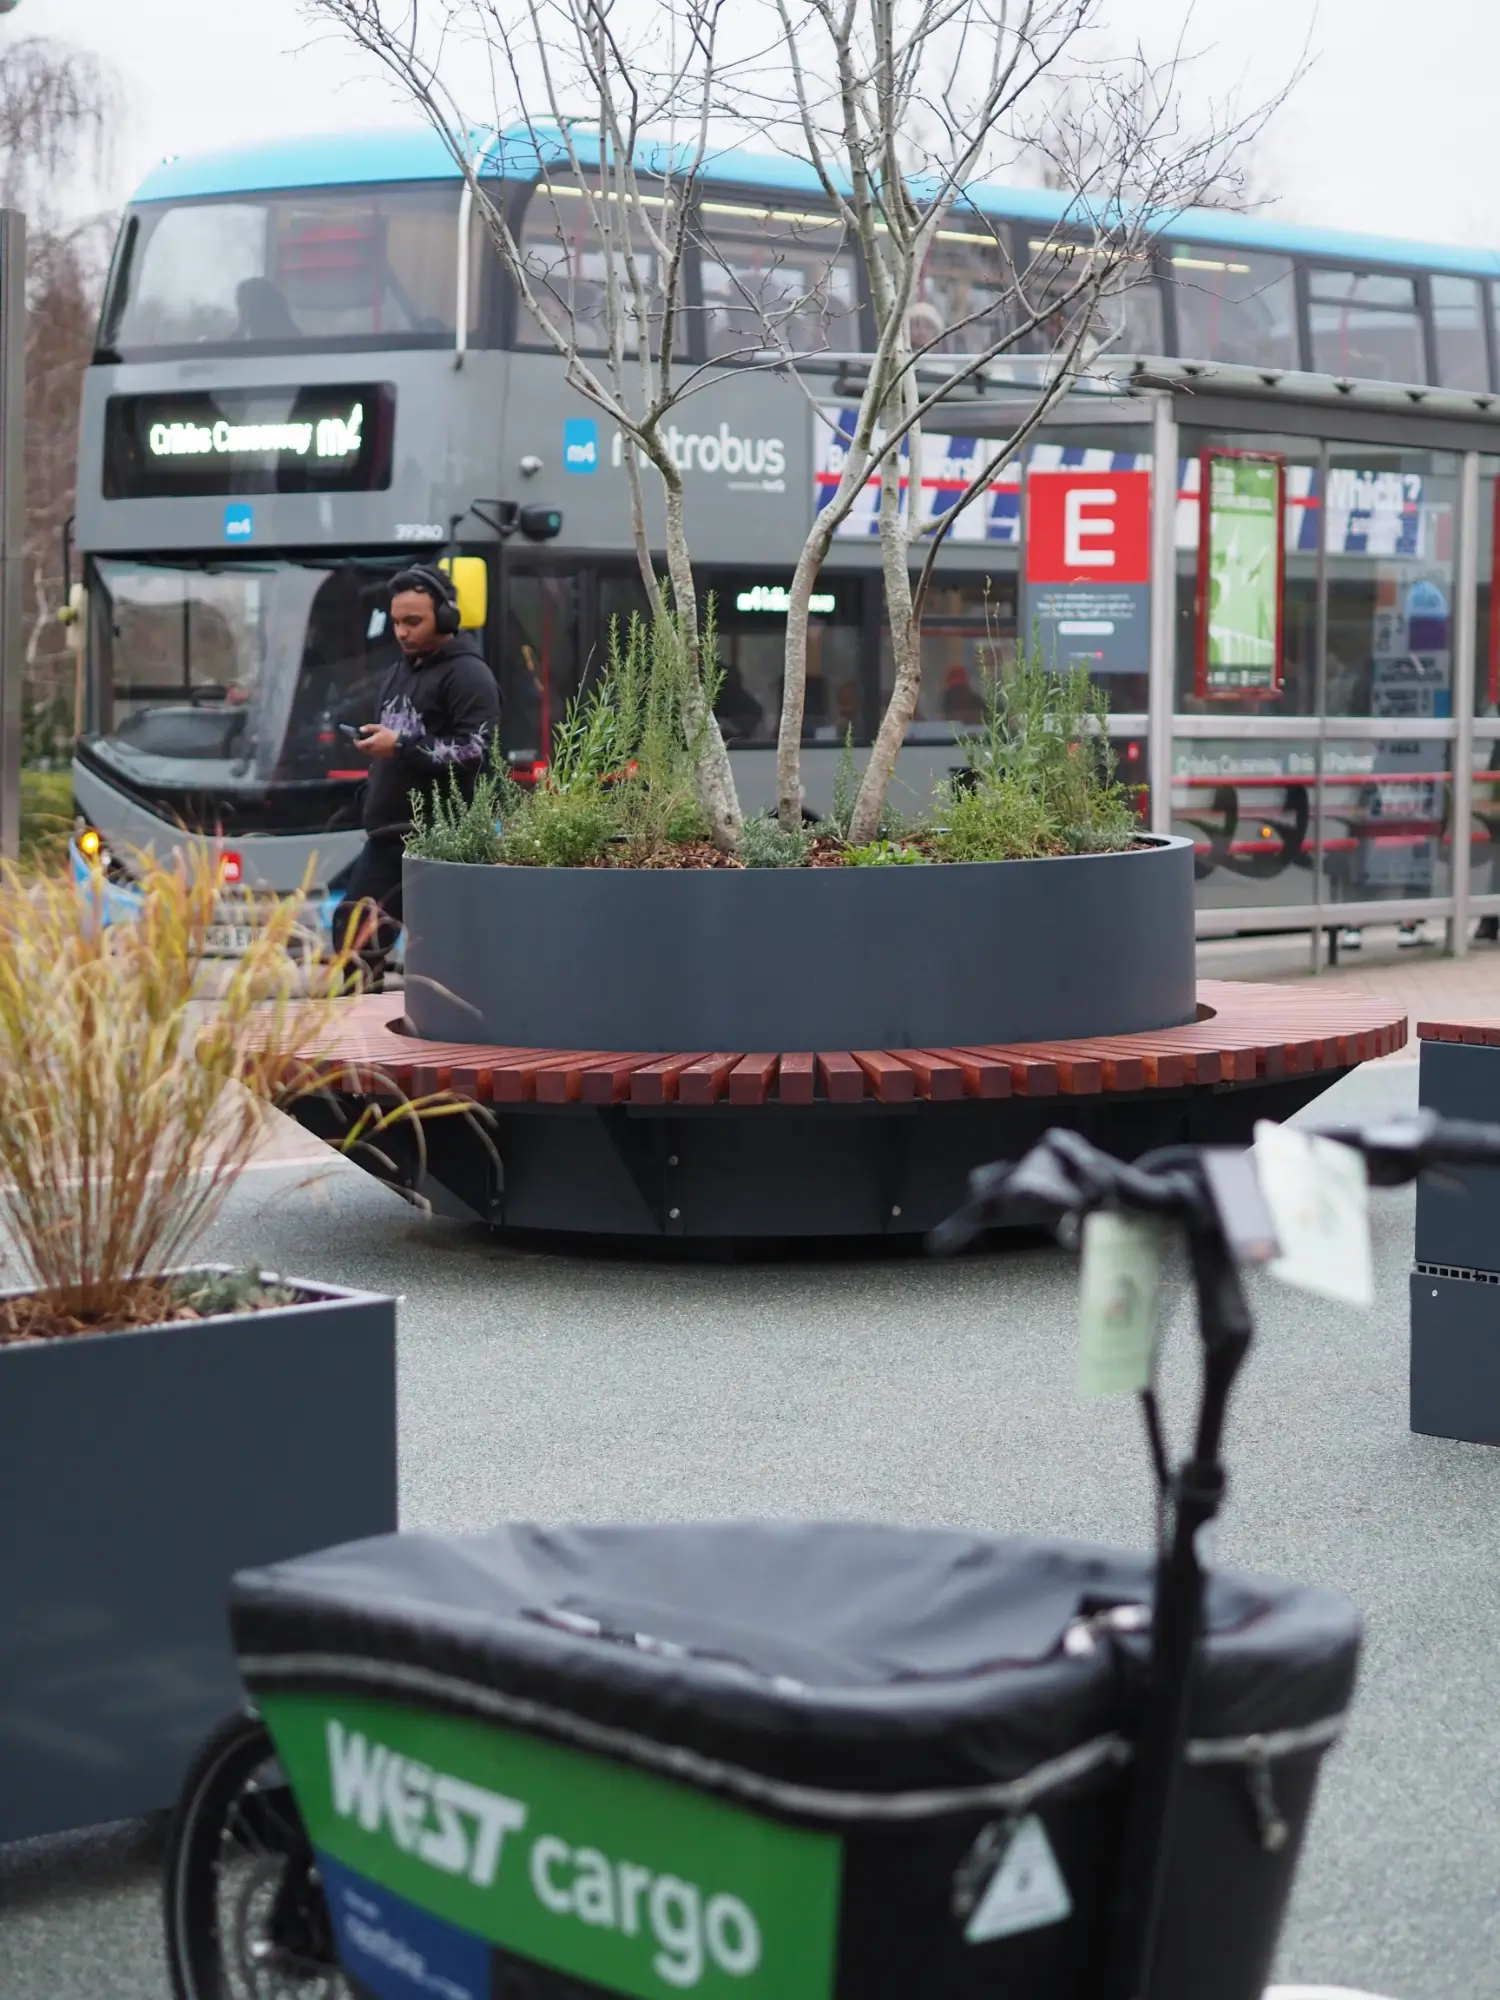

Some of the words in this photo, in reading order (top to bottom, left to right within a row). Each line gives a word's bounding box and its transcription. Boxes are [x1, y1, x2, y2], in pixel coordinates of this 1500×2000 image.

[568, 441, 595, 463] m4
[612, 422, 785, 475] mtrobus
[1064, 489, 1117, 566] E
[326, 1718, 528, 1887] WEST
[529, 1834, 762, 1988] cargo
